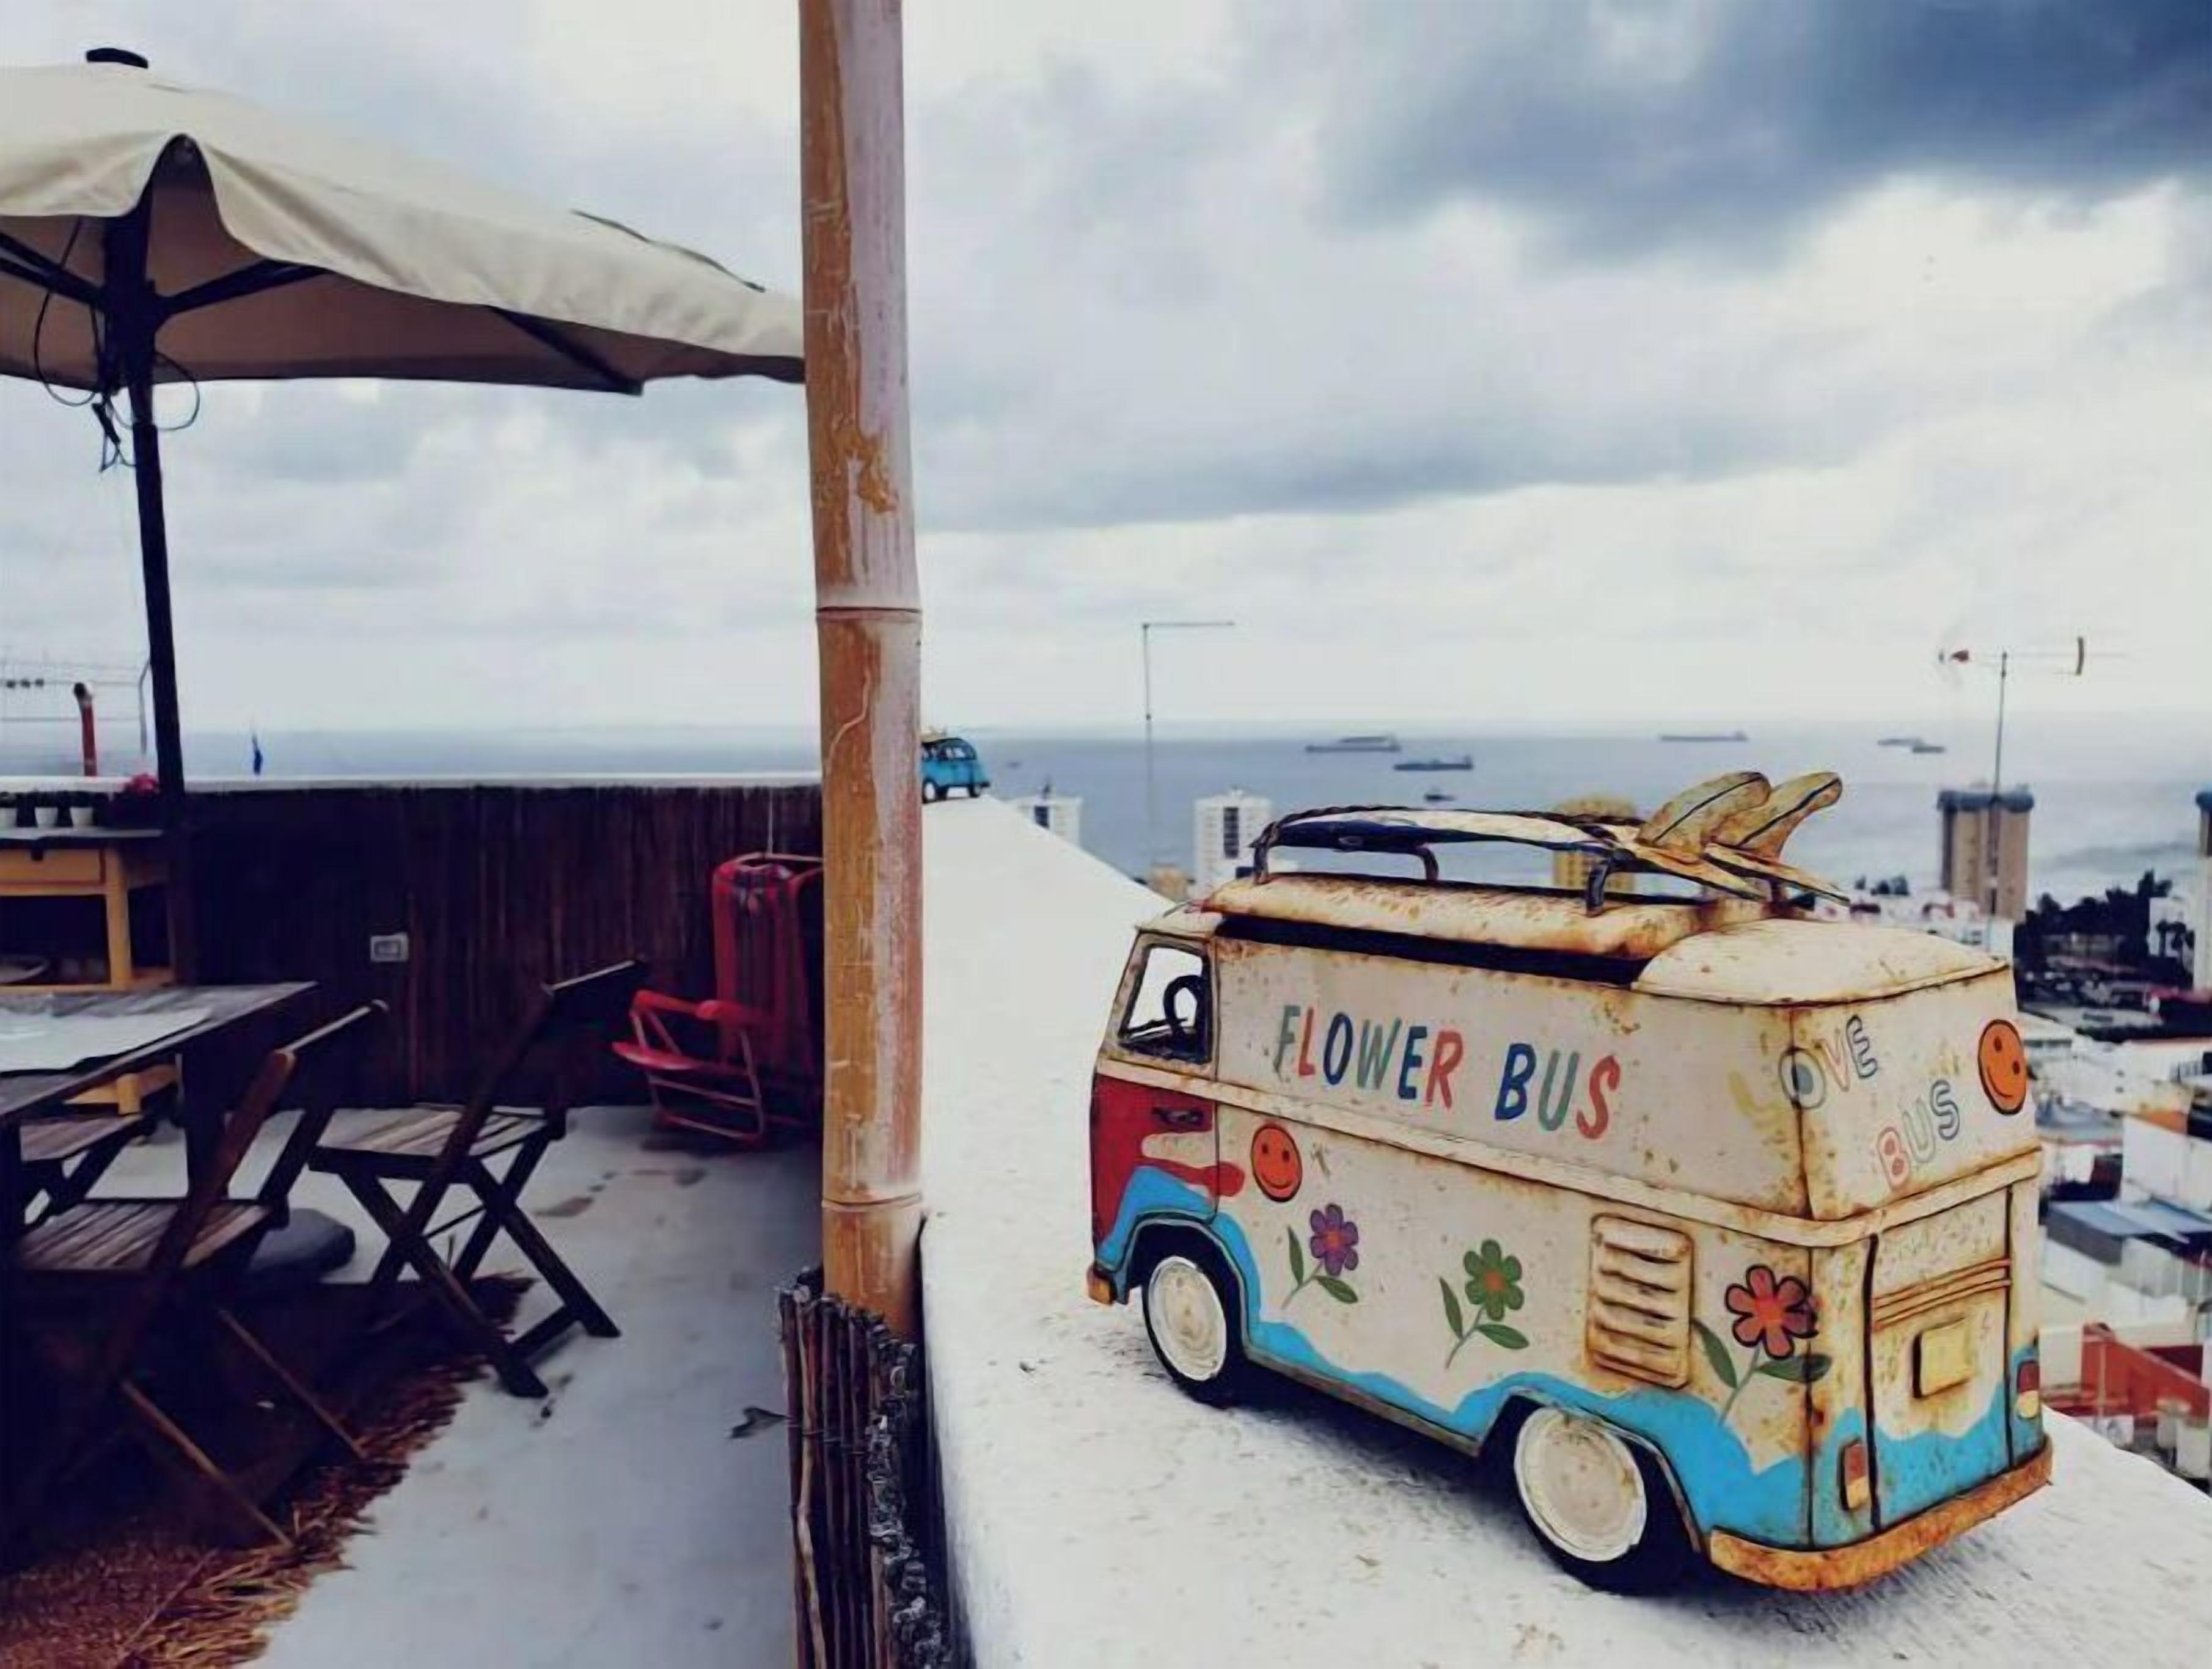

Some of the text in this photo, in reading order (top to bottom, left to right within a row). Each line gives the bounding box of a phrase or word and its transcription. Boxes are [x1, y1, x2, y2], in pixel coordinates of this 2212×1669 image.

[1273, 1004, 1621, 1140] FLOWER BUS
[1876, 1079, 1961, 1193] BUS
